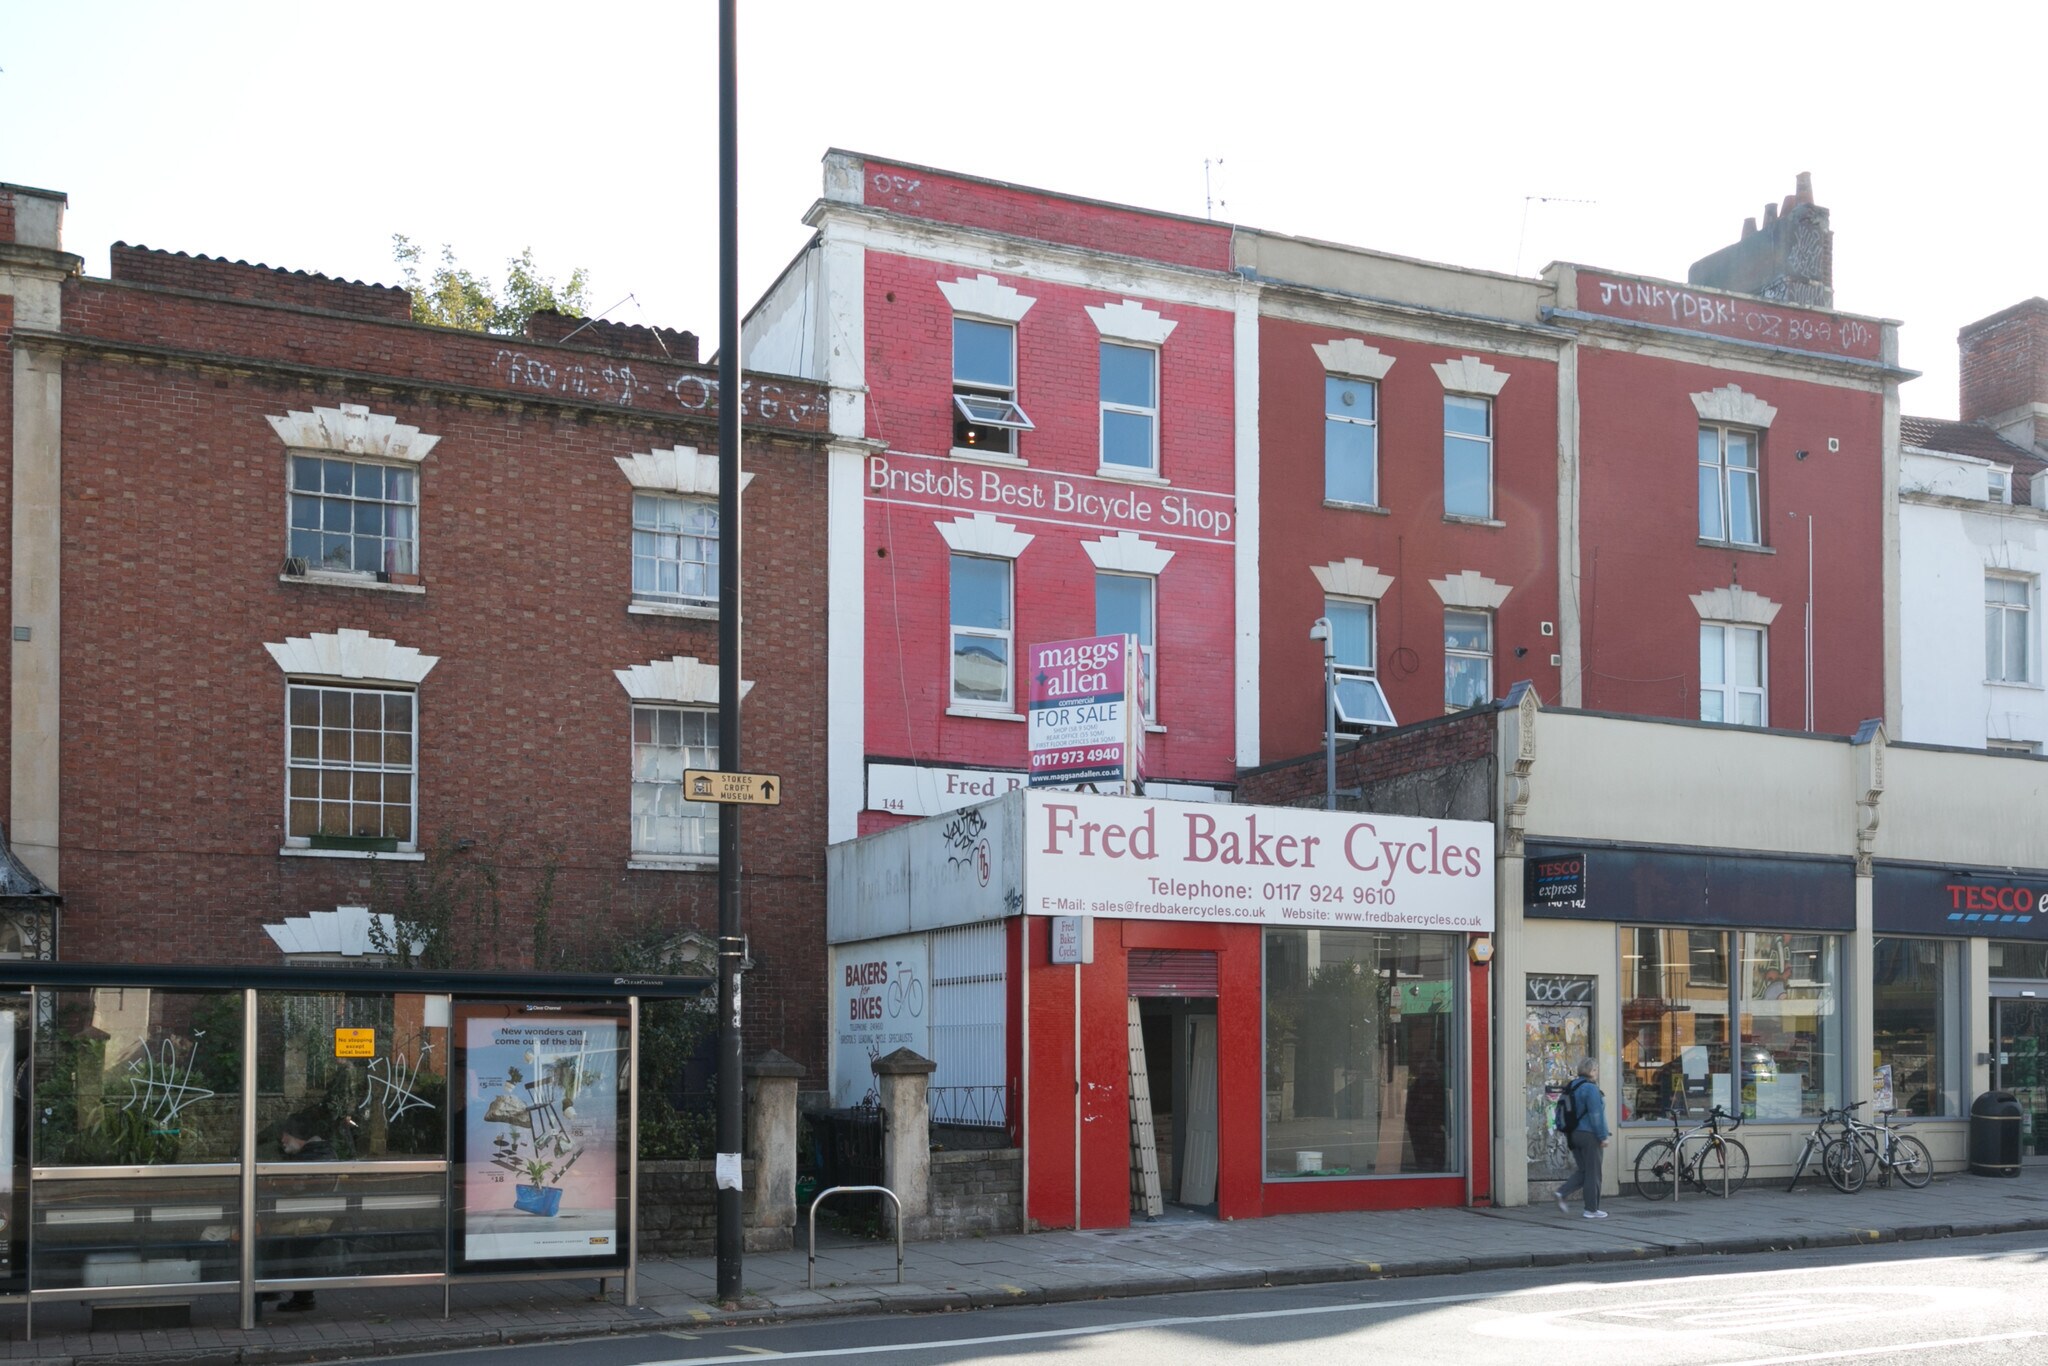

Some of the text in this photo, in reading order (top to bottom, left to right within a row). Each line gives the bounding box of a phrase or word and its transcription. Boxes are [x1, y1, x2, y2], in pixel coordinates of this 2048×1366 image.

[870, 456, 1231, 537] Bristol's Best Bicycle Shop
[1039, 641, 1119, 672] maggs
[1048, 667, 1108, 696] allen
[1058, 696, 1094, 706] commercial
[1037, 703, 1117, 728] FOR SALE
[1032, 747, 1119, 767] 0117 973 4940
[721, 774, 753, 784] STOKES
[1031, 768, 1121, 782] www.maggsandallen.co.uk
[724, 783, 750, 792] CROFT
[946, 773, 995, 797] Fred
[720, 792, 754, 801] MUSEUM
[882, 798, 904, 811] 144
[1041, 803, 1159, 861] Fred
[1183, 812, 1321, 869] Baker
[1343, 821, 1482, 887] Cycles
[1538, 861, 1580, 877] TESCO
[1148, 876, 1396, 906] Telephone: 0117 924 9610
[1538, 884, 1578, 900] express
[1946, 884, 2033, 913] TESCO
[1042, 897, 1482, 927] E-Mail: sales@fredbakercycles.co.uk Website: www.fredbakercycles.co.uk
[1570, 899, 1586, 909] 142
[1061, 920, 1075, 932] Fred
[1060, 932, 1076, 945] Baker
[1058, 945, 1077, 960] Cycles
[846, 961, 888, 987] BAKERS
[850, 996, 883, 1020] BIKES
[501, 1027, 583, 1036] New wonders can
[495, 1038, 520, 1046] come
[540, 1037, 550, 1046] of
[551, 1037, 568, 1046] the
